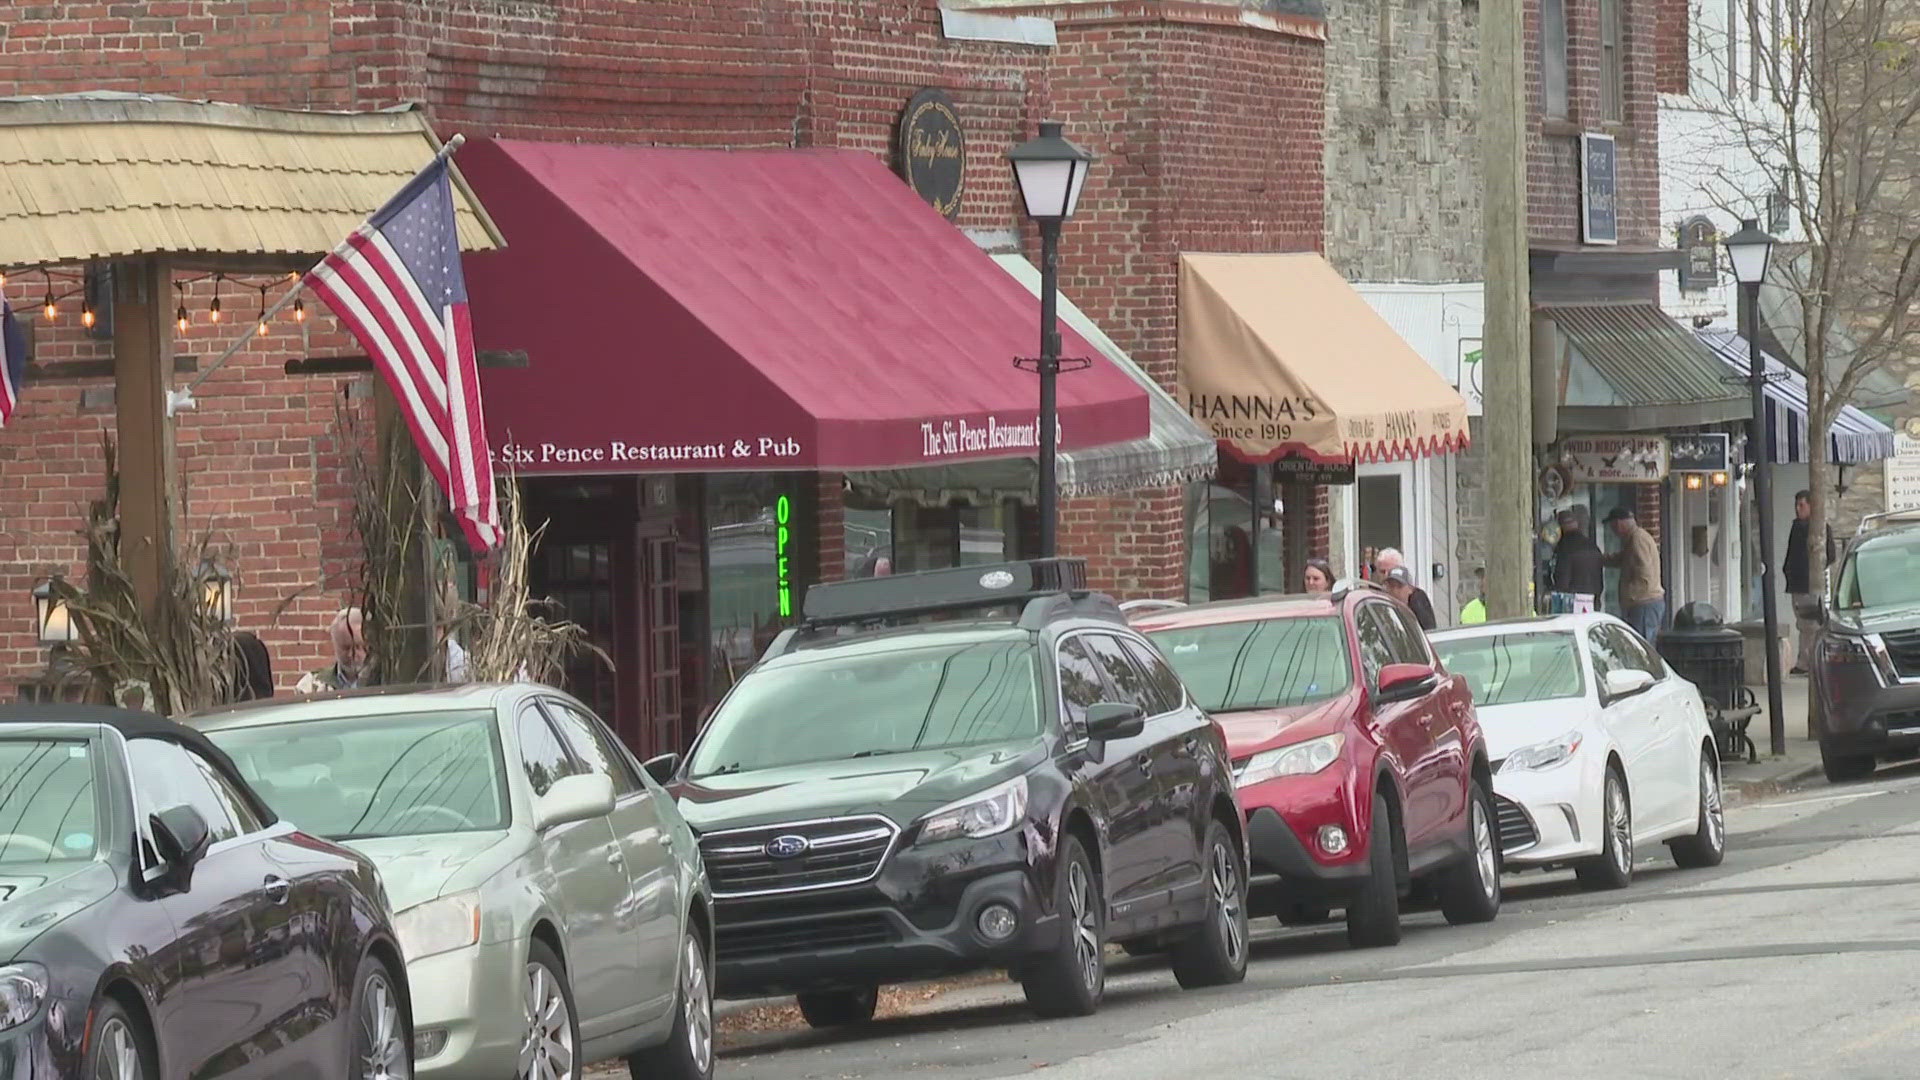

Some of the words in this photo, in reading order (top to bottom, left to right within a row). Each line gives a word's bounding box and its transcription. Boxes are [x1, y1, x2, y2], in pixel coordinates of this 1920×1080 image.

[1189, 392, 1316, 421] HANNA'S
[921, 422, 941, 456] The
[943, 420, 958, 454] Six
[959, 418, 987, 452] Pence
[988, 416, 1034, 449] Restaurant
[1211, 423, 1254, 439] Since
[1261, 424, 1292, 440] 1919
[502, 443, 534, 462] Six
[541, 442, 604, 463] Pence
[610, 441, 725, 462] Restaurant
[731, 439, 751, 458] &
[757, 437, 801, 457] Pub
[777, 495, 790, 617] OPEN
